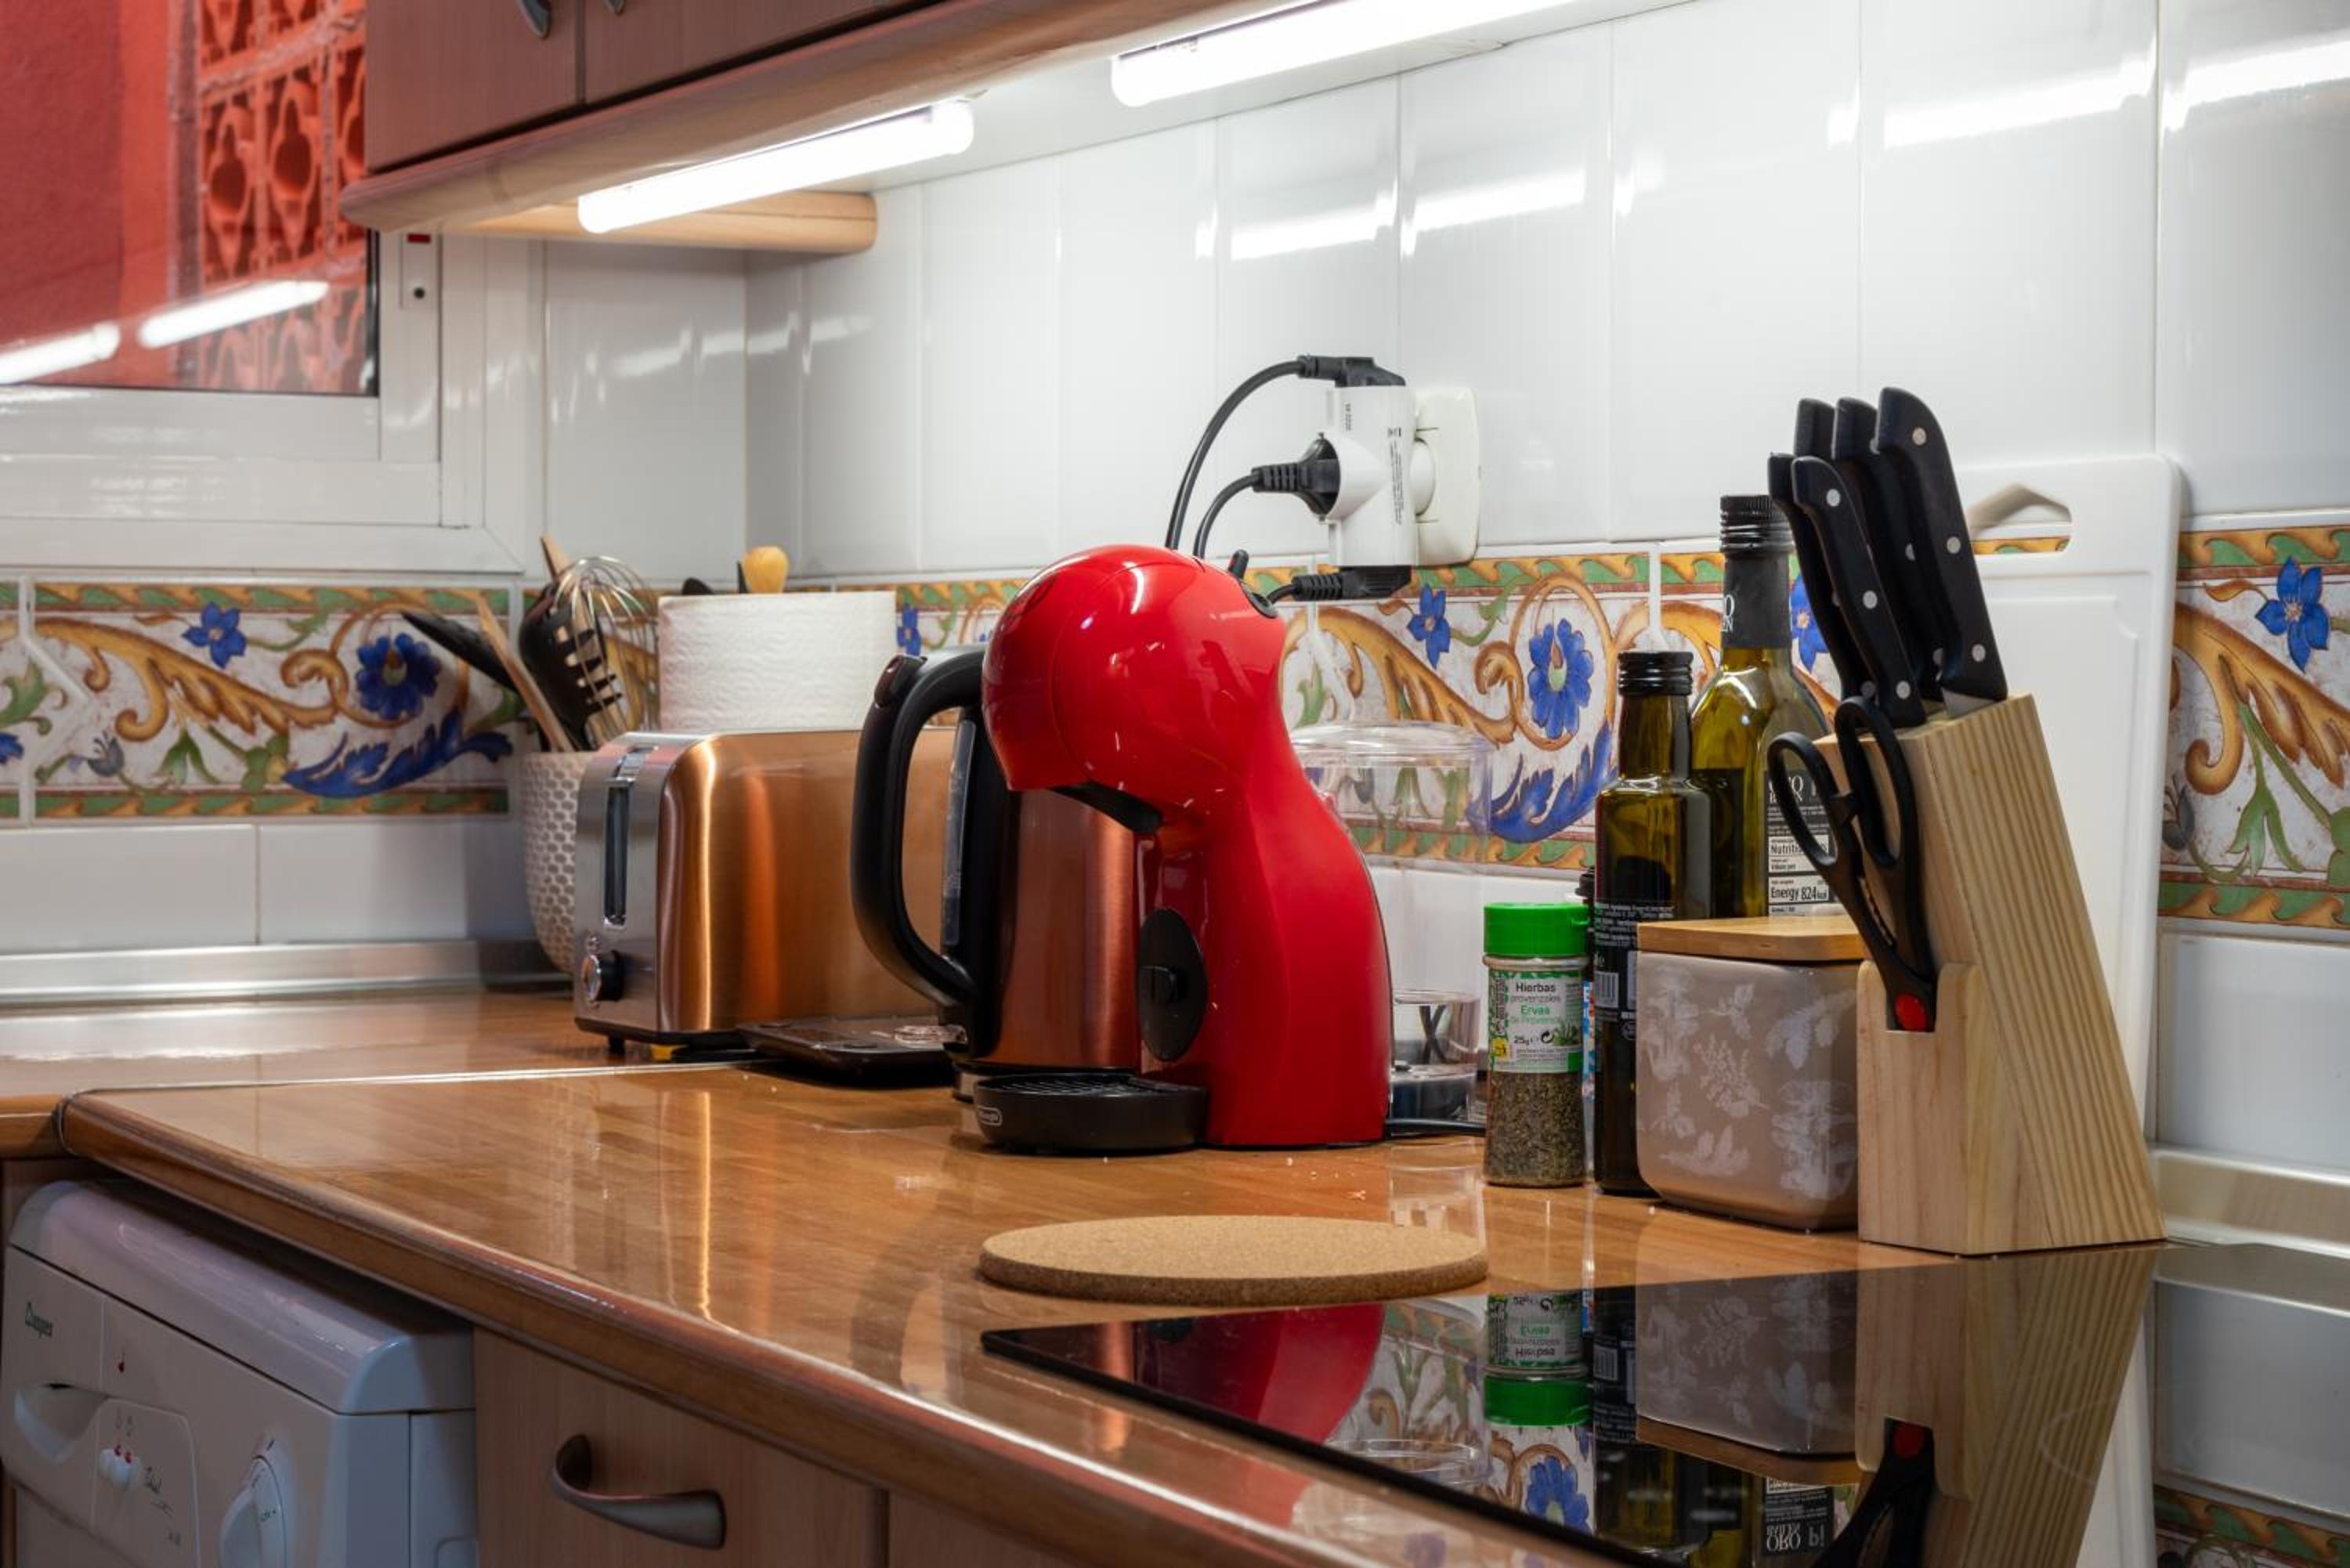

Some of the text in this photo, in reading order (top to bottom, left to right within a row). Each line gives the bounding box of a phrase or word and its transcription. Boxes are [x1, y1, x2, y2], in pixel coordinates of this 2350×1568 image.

[1770, 886, 1799, 901] Energy
[1801, 885, 1817, 900] 824
[1516, 982, 1556, 992] Hierbas
[1520, 1005, 1551, 1015] Ervas
